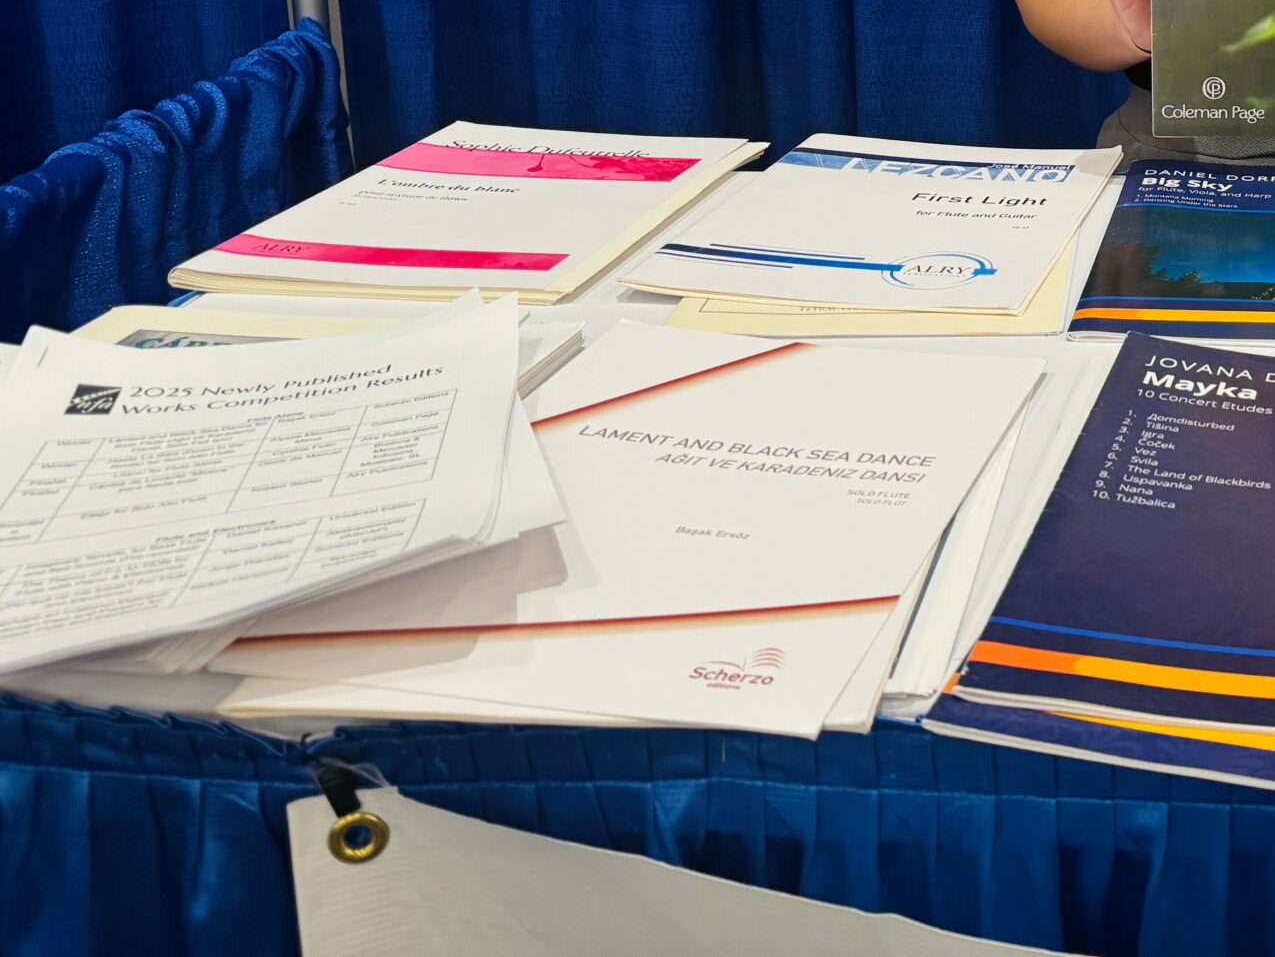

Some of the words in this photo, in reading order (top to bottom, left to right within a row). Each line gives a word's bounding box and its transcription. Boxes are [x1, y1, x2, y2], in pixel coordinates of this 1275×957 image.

[1161, 104, 1228, 119] Coleman
[1232, 105, 1266, 124] Page
[452, 139, 526, 153] Sophie
[840, 156, 1069, 182] LEZCANO
[1023, 163, 1071, 171] Manuel
[1144, 169, 1217, 180] DANIEL
[448, 183, 471, 191] du
[475, 185, 521, 193] blanc
[1142, 177, 1181, 188] Big
[1187, 178, 1233, 192] Sky
[911, 192, 972, 204] First
[982, 195, 1049, 207] Light
[1156, 186, 1186, 194] Flute,
[1189, 189, 1218, 197] Viola,
[1244, 192, 1272, 200] Harp
[936, 210, 969, 219] Flute
[905, 264, 972, 274] ALRY
[1145, 355, 1253, 380] JOVANA
[129, 386, 193, 398] 2025
[201, 383, 276, 397] Newly
[283, 364, 392, 390] Published
[1142, 371, 1258, 401] Mayka
[122, 403, 197, 414] Works
[207, 383, 357, 410] Competition
[366, 366, 444, 389] Results
[1137, 388, 1155, 398] 10
[1159, 392, 1217, 408] Concert
[1222, 401, 1273, 415] Etudes
[1145, 421, 1180, 433] Tišina
[1141, 430, 1165, 440] Igra
[577, 425, 673, 446] LAMENT
[672, 437, 725, 452] AND
[727, 442, 805, 460] BLACK
[806, 449, 854, 462] SEA
[856, 452, 937, 468] DANCE
[1138, 437, 1176, 451] Čoček
[1134, 447, 1157, 457] Vez
[655, 452, 706, 467] AĞIT
[709, 457, 738, 469] VE
[859, 469, 927, 483] DANSI
[1130, 455, 1159, 467] Svila
[1123, 474, 1193, 491] Uspavanka
[1127, 464, 1151, 475] The
[1154, 470, 1186, 480] Land
[1189, 474, 1204, 482] of
[1205, 475, 1272, 490] Blackbirds
[846, 489, 876, 498] SOLO
[878, 490, 912, 500] FLUTE
[1119, 483, 1154, 496] Nana
[1115, 493, 1176, 509] Tužbalica
[675, 525, 712, 538] Başak
[714, 529, 751, 540] Ersöz
[688, 666, 774, 686] Scherzo
